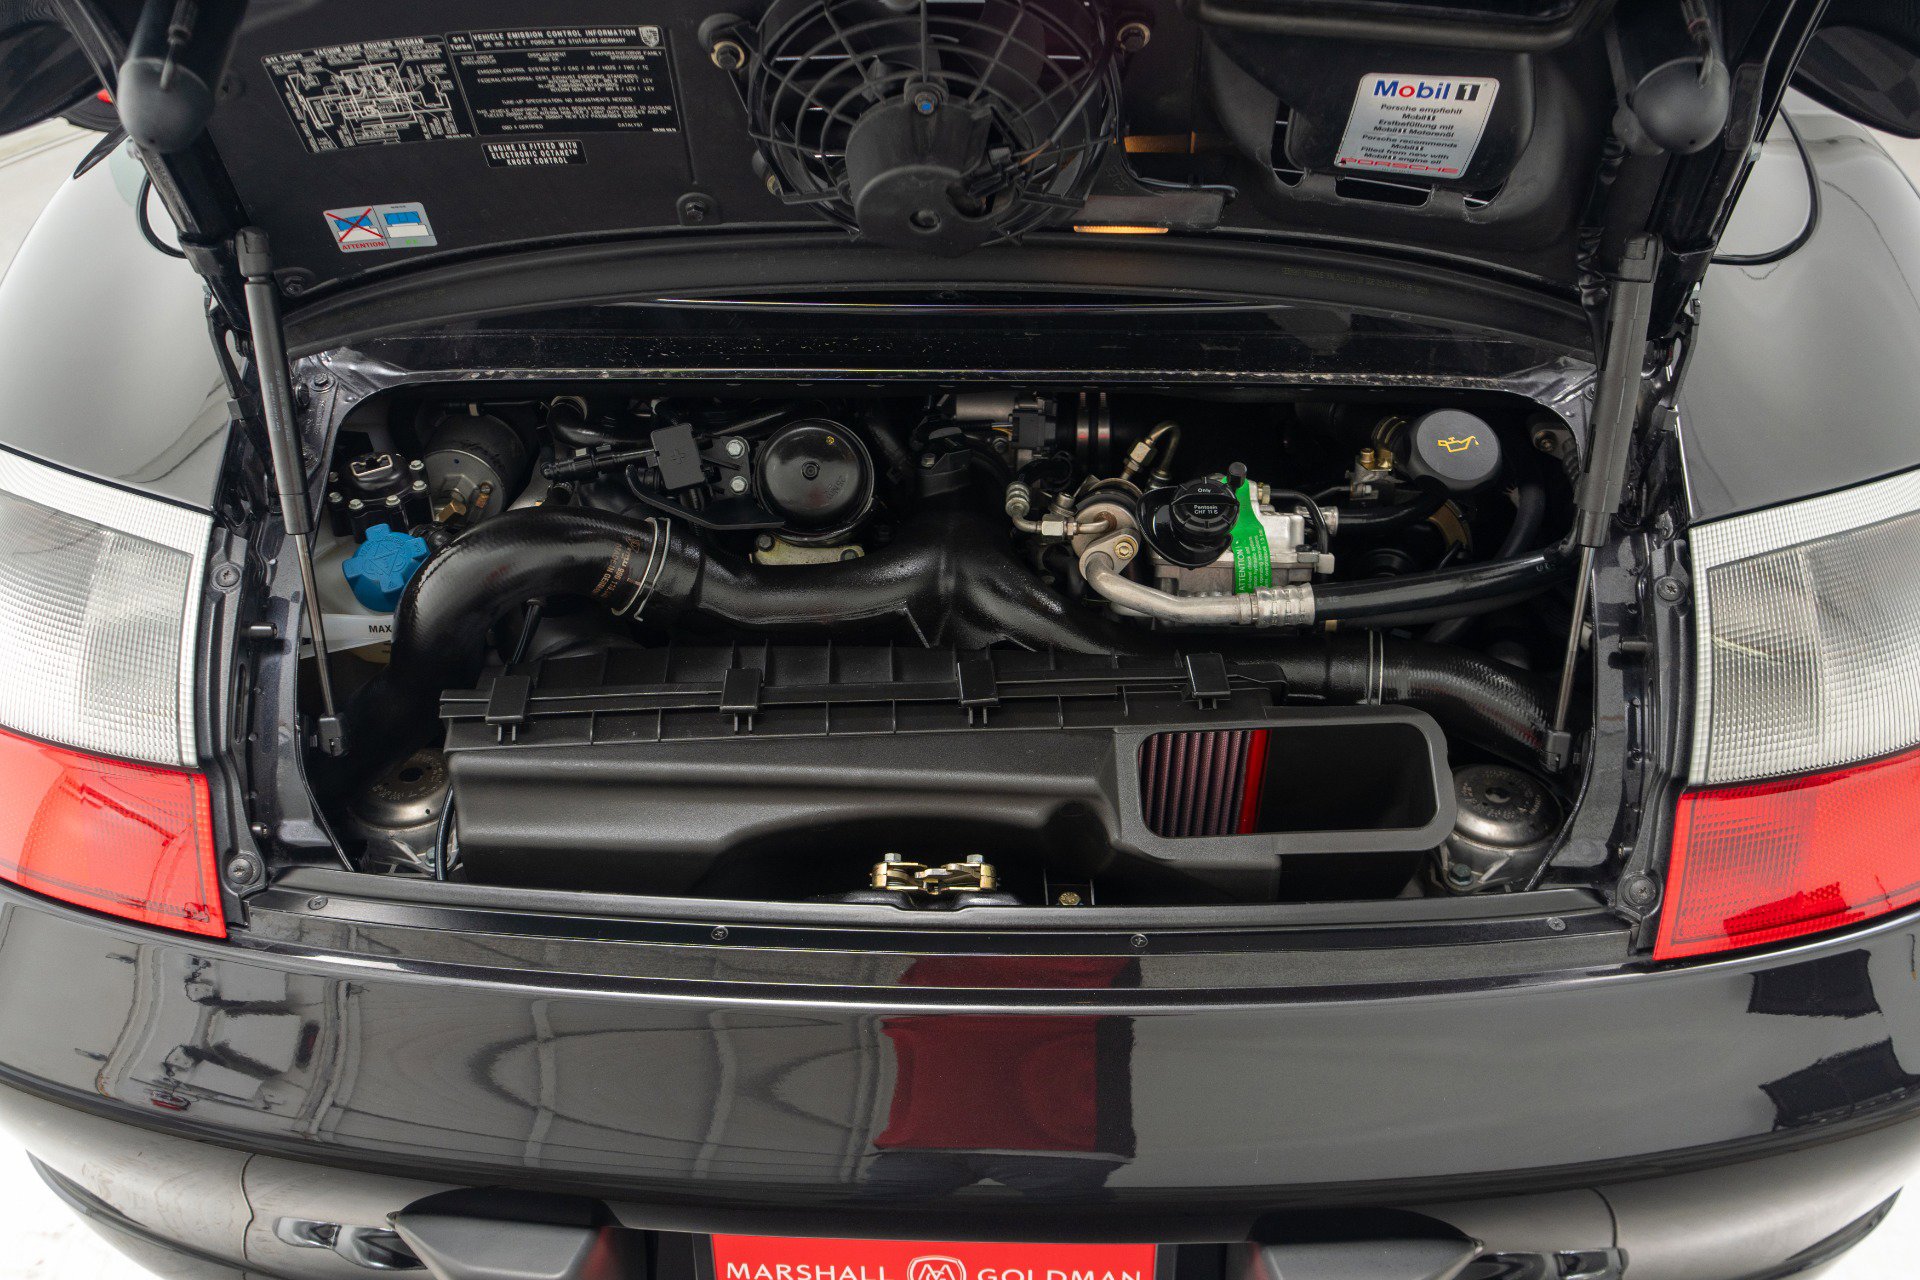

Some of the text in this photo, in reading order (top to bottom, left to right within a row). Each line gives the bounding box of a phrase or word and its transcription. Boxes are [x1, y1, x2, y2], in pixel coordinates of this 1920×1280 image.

[473, 28, 637, 42] VEHICLE EMISSION CONTROL INFORMATION
[1373, 79, 1451, 99] Mobil
[1380, 103, 1417, 112] Porsche
[1402, 113, 1427, 121] Mobil
[1378, 119, 1437, 130] Erstbefüllung
[1408, 129, 1455, 138] Motorenöl
[1362, 134, 1458, 148] Porsche recommends
[488, 141, 578, 152] ENGINE IS FITTED WITH
[1360, 146, 1385, 154] Filled
[1387, 148, 1407, 156] from
[491, 150, 537, 160] ELECTRONIC
[1398, 156, 1428, 164] engine
[507, 156, 569, 166] KNOCK CONTROL
[1341, 157, 1458, 173] PORSCHE
[342, 240, 387, 251] ATTENTION!
[368, 624, 393, 633] MAX
[727, 1262, 894, 1280] MARSHALL
[977, 1268, 1140, 1280] GOLDMAN
